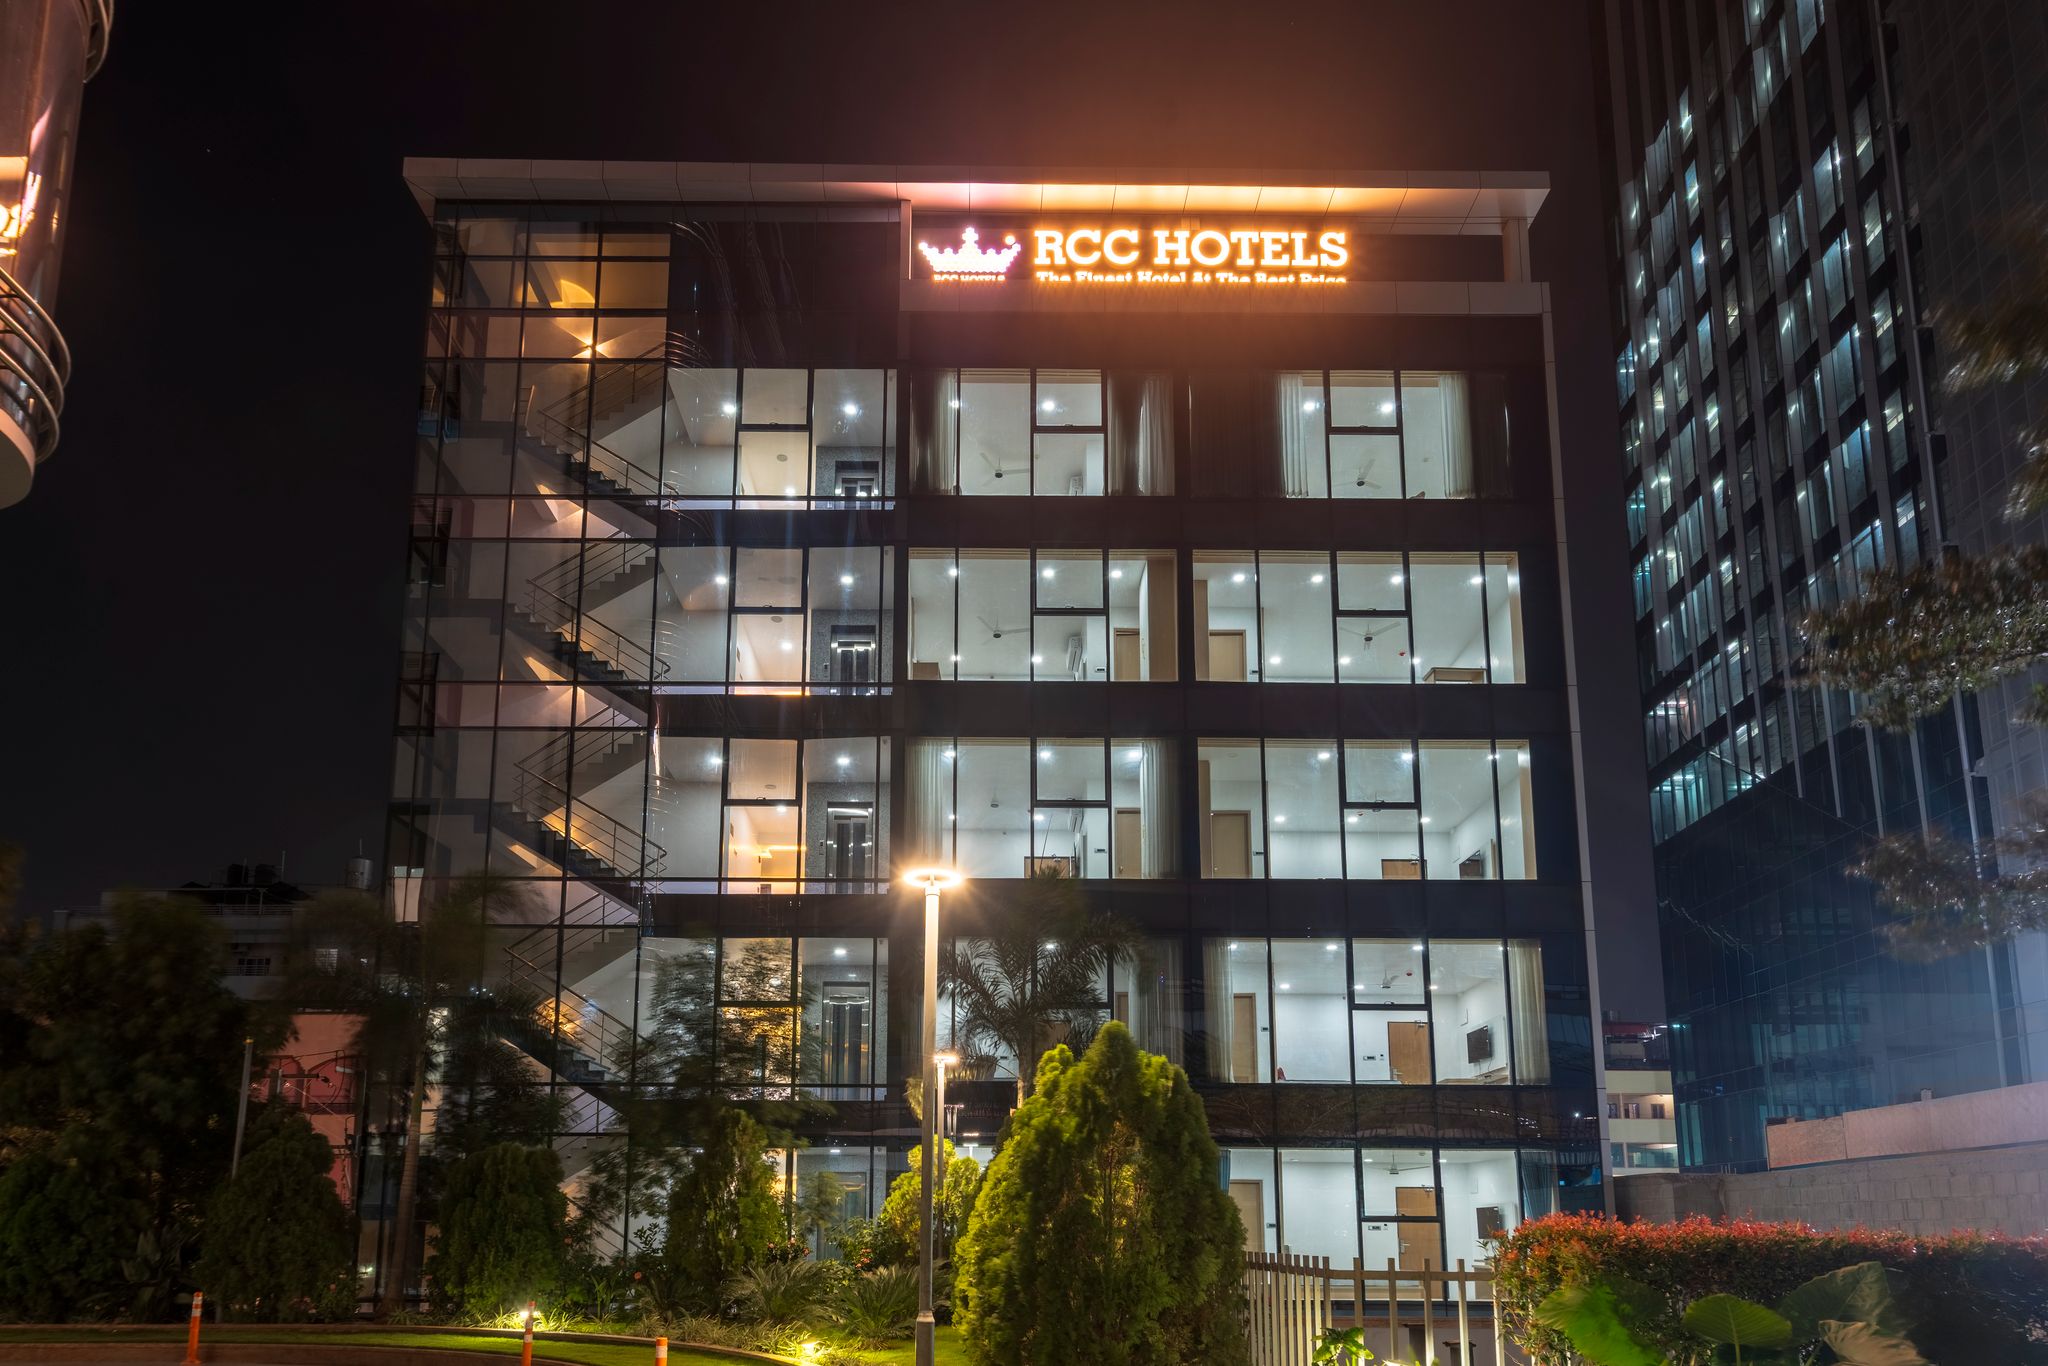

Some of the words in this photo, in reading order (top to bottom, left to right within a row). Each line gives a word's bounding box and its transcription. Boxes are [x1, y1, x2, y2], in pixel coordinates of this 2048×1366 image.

[1034, 229, 1140, 266] RCC
[1153, 229, 1348, 267] HOTELS
[1036, 271, 1071, 282] The
[1075, 271, 1132, 282] Finest
[1137, 271, 1186, 283] Hotel
[1193, 271, 1212, 283] At
[1216, 271, 1251, 283] The
[1255, 272, 1295, 283] Best
